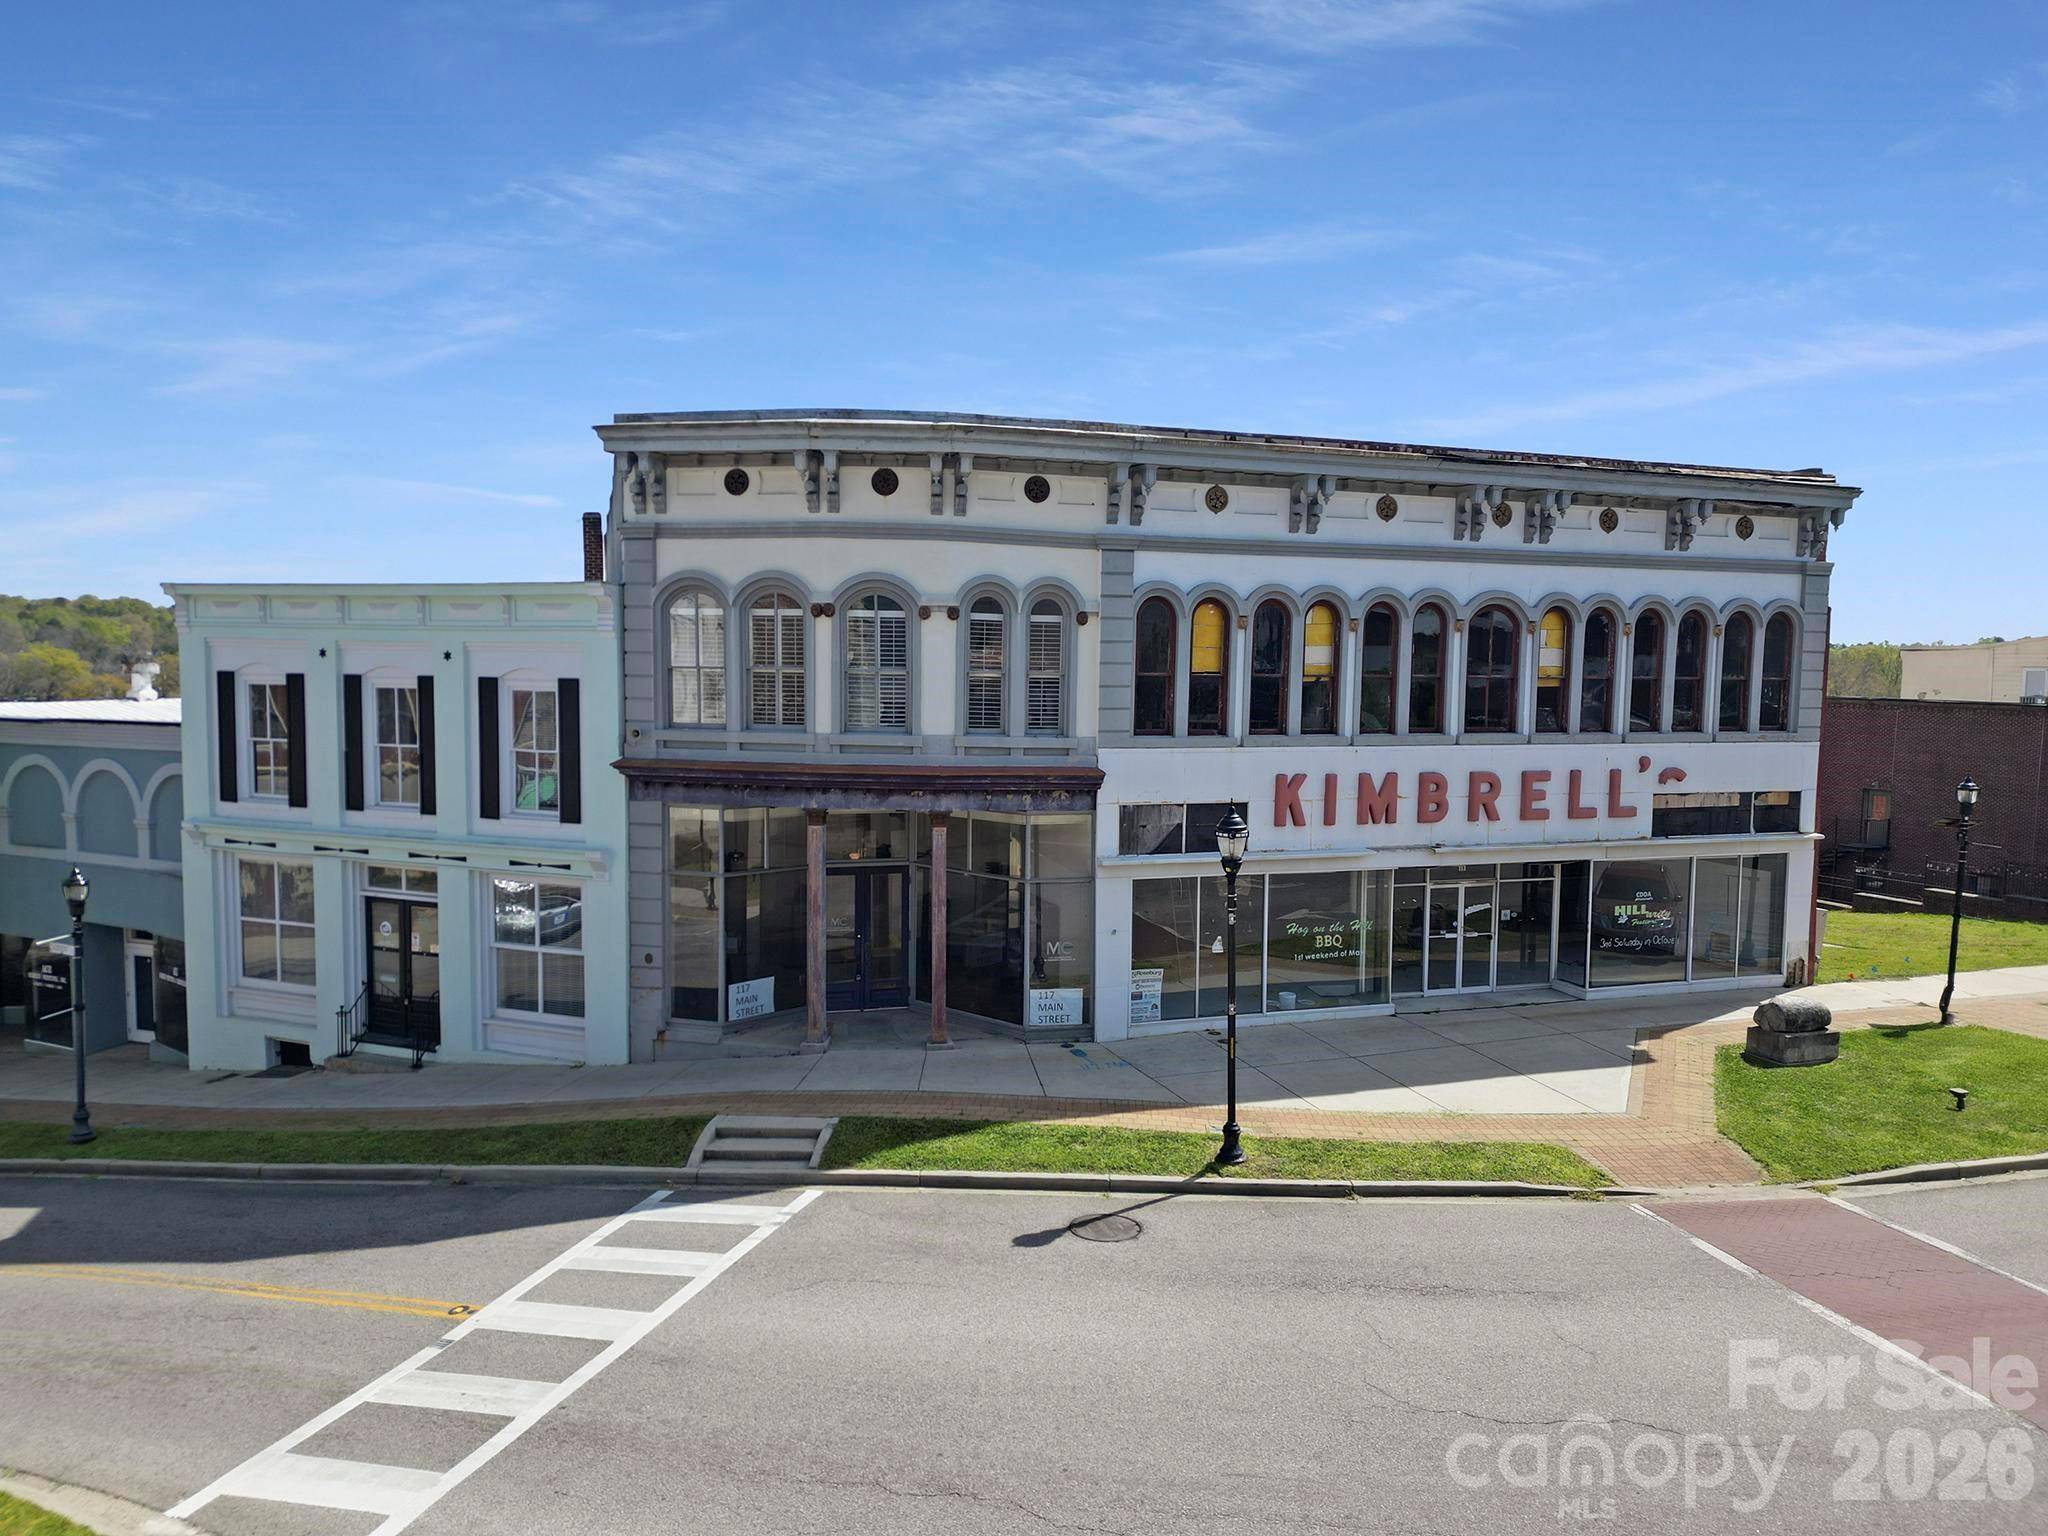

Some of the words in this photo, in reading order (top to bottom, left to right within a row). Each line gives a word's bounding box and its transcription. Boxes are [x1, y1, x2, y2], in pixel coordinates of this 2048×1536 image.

[1273, 755, 1688, 828] KIMBRELL'
[1286, 922, 1309, 937] Hog
[1329, 921, 1344, 932] the
[1315, 934, 1343, 948] BBQ
[1613, 937, 1643, 950] Saturday
[1294, 953, 1304, 961] 1st
[1305, 951, 1339, 960] weekend
[1340, 950, 1347, 958] of
[736, 983, 751, 994] 117
[735, 994, 758, 1006] MAIN
[1038, 991, 1055, 1001] 117
[735, 1004, 765, 1018] STREET
[1037, 1002, 1064, 1012] MAIN
[1038, 1014, 1071, 1024] STREET
